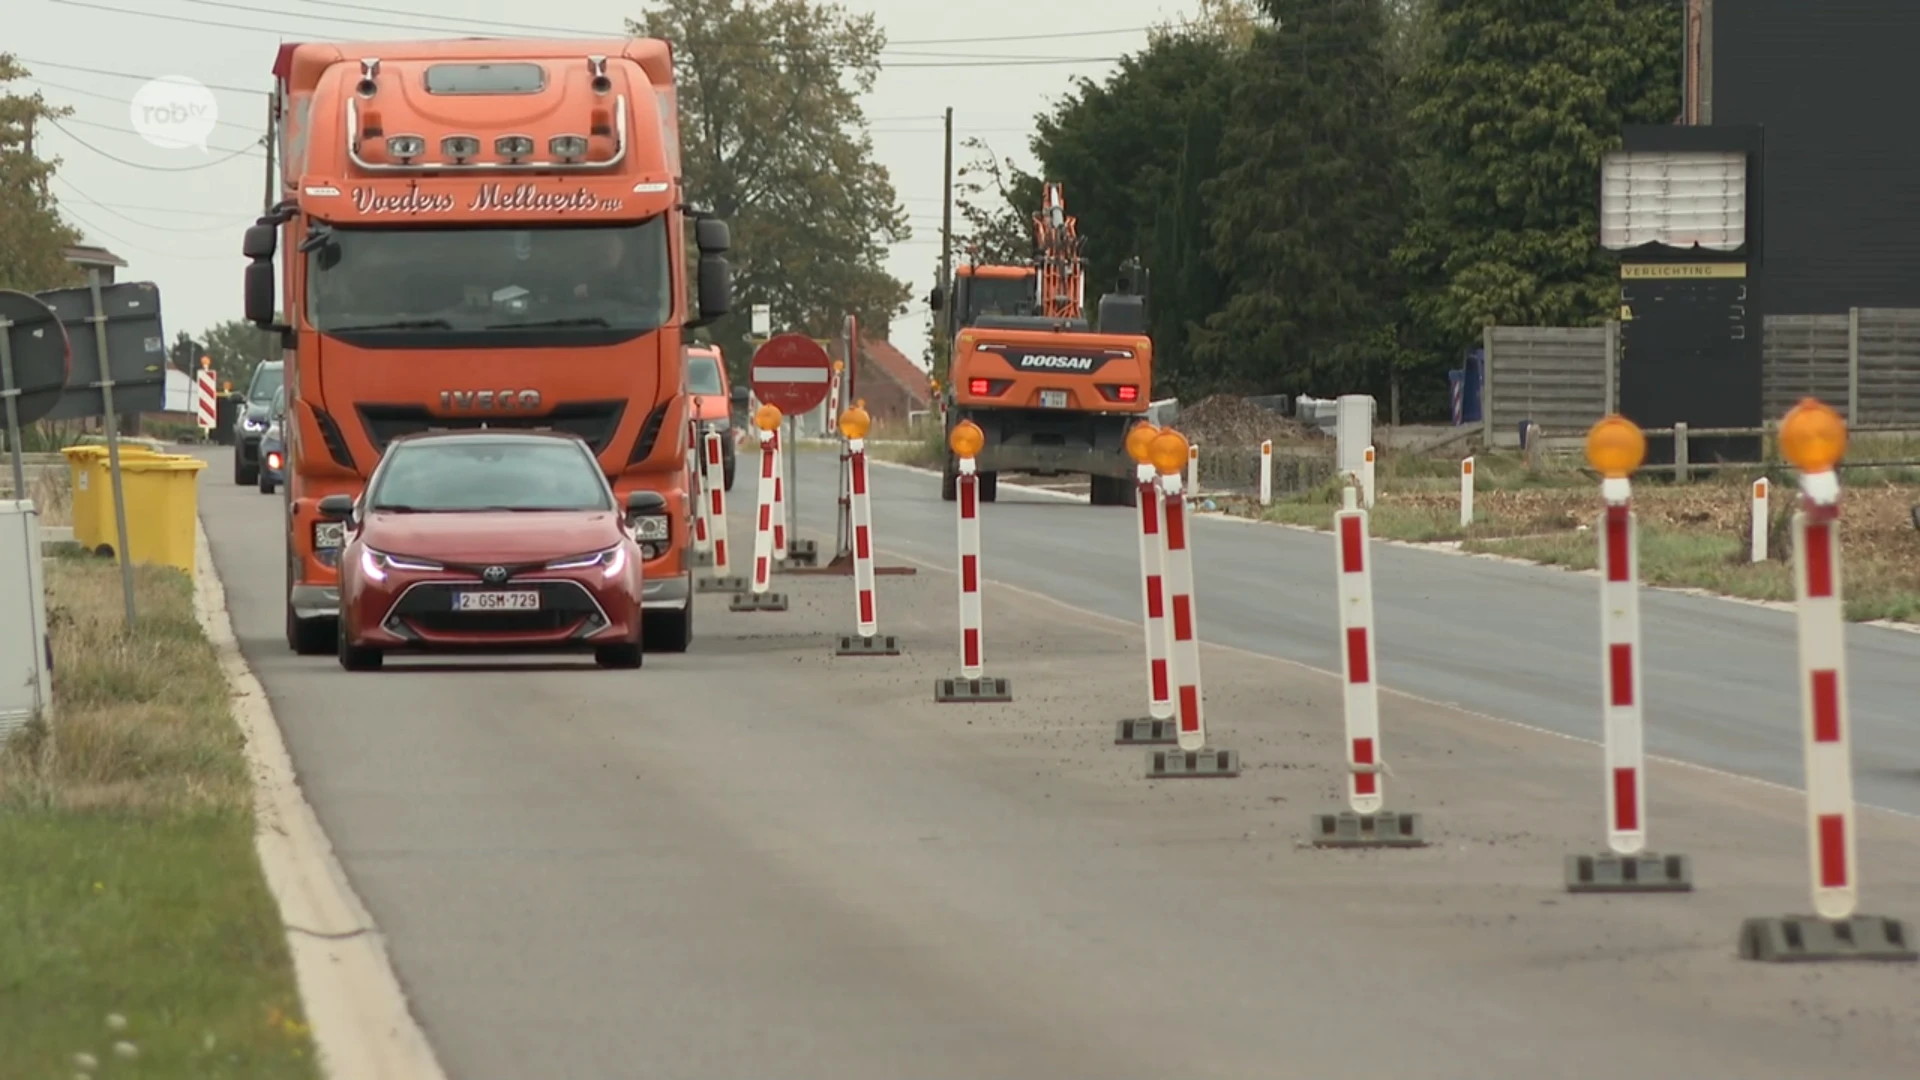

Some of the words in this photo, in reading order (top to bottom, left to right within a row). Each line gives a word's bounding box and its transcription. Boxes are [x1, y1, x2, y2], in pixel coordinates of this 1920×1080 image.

[352, 186, 455, 215] Voeders
[468, 183, 598, 212] Mellaerts
[1624, 266, 1713, 276] VERLICHTING
[1020, 354, 1093, 370] DOOSAN
[440, 390, 541, 410] IVECO
